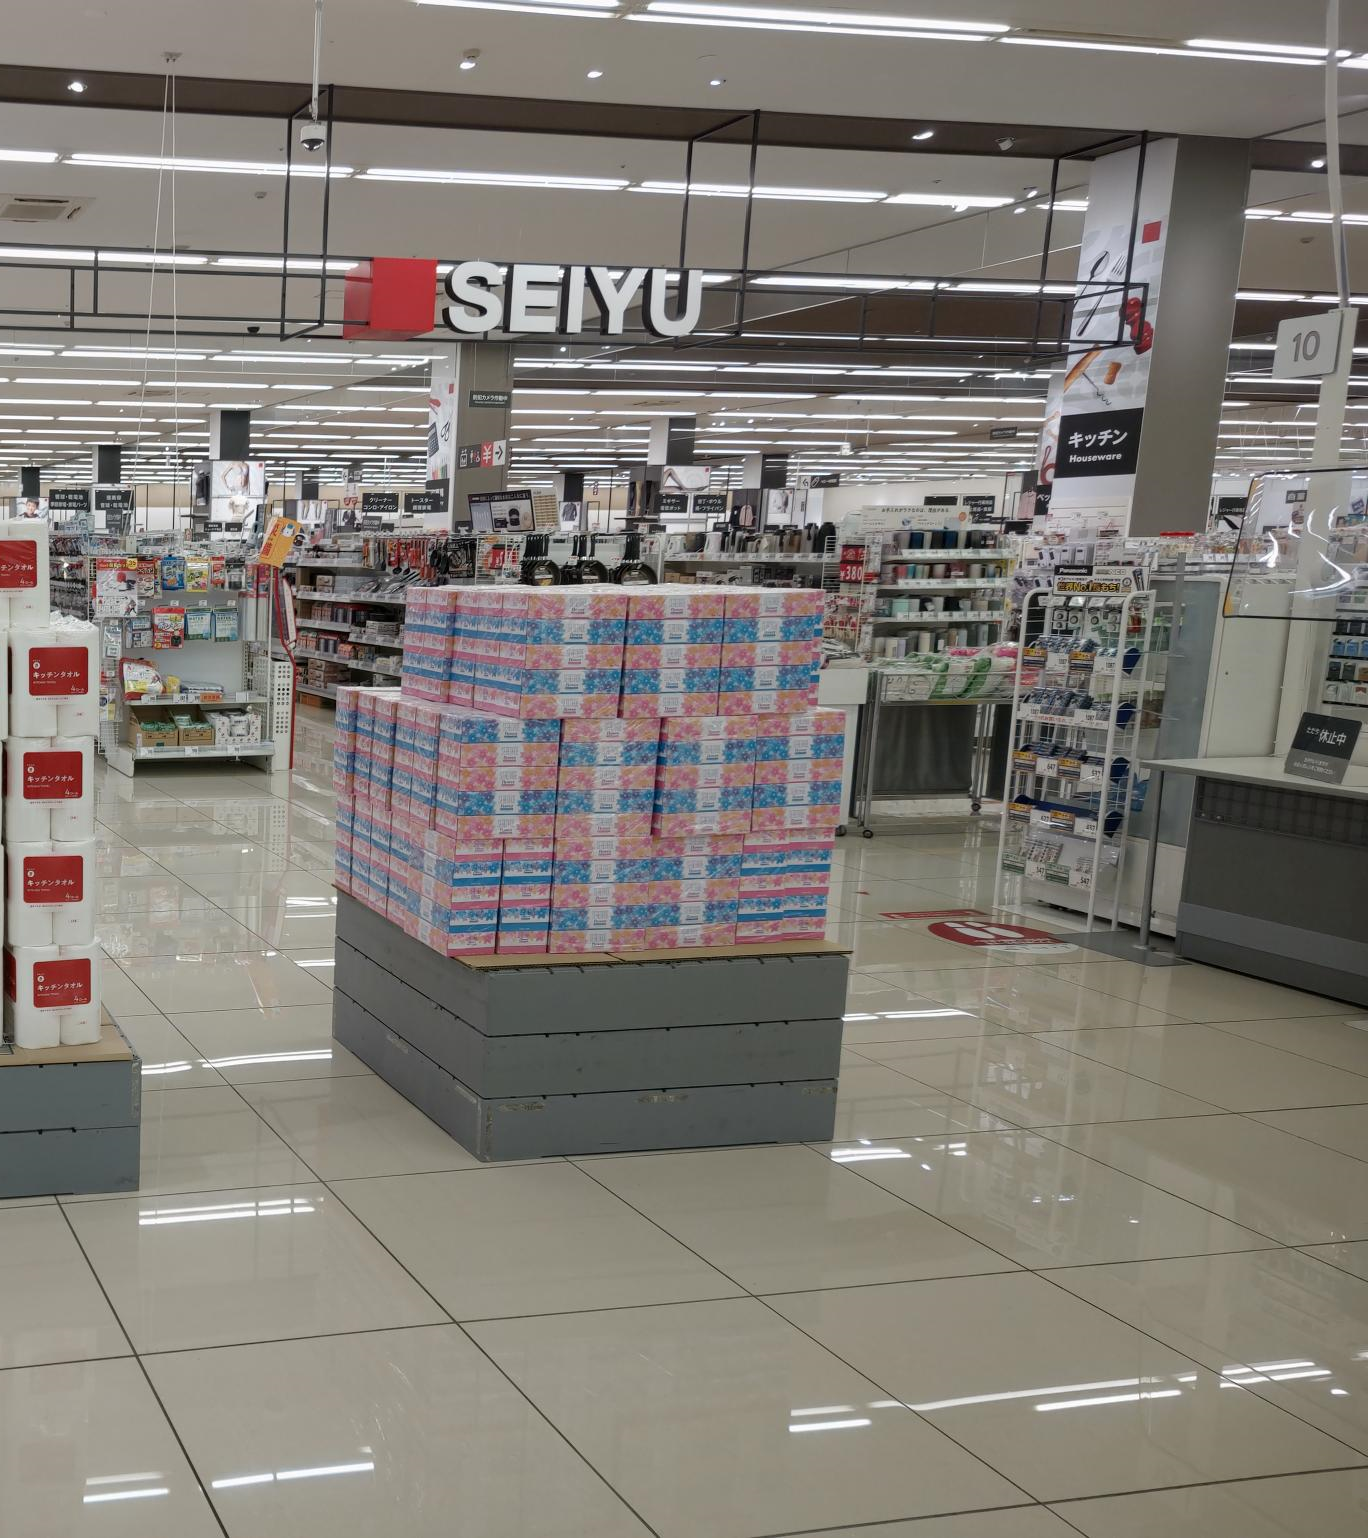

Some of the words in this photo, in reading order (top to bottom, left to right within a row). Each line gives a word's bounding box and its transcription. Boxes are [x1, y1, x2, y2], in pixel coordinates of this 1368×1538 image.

[442, 261, 703, 337] SEIYU
[1293, 331, 1320, 362] 10
[1068, 429, 1128, 448] キッチン
[1069, 453, 1122, 463] Houseware
[1059, 567, 1088, 575] Panasonic
[33, 671, 80, 679] キッチンタオル
[27, 775, 74, 783] キッチンタオル
[37, 982, 83, 992] キッチンタオル
